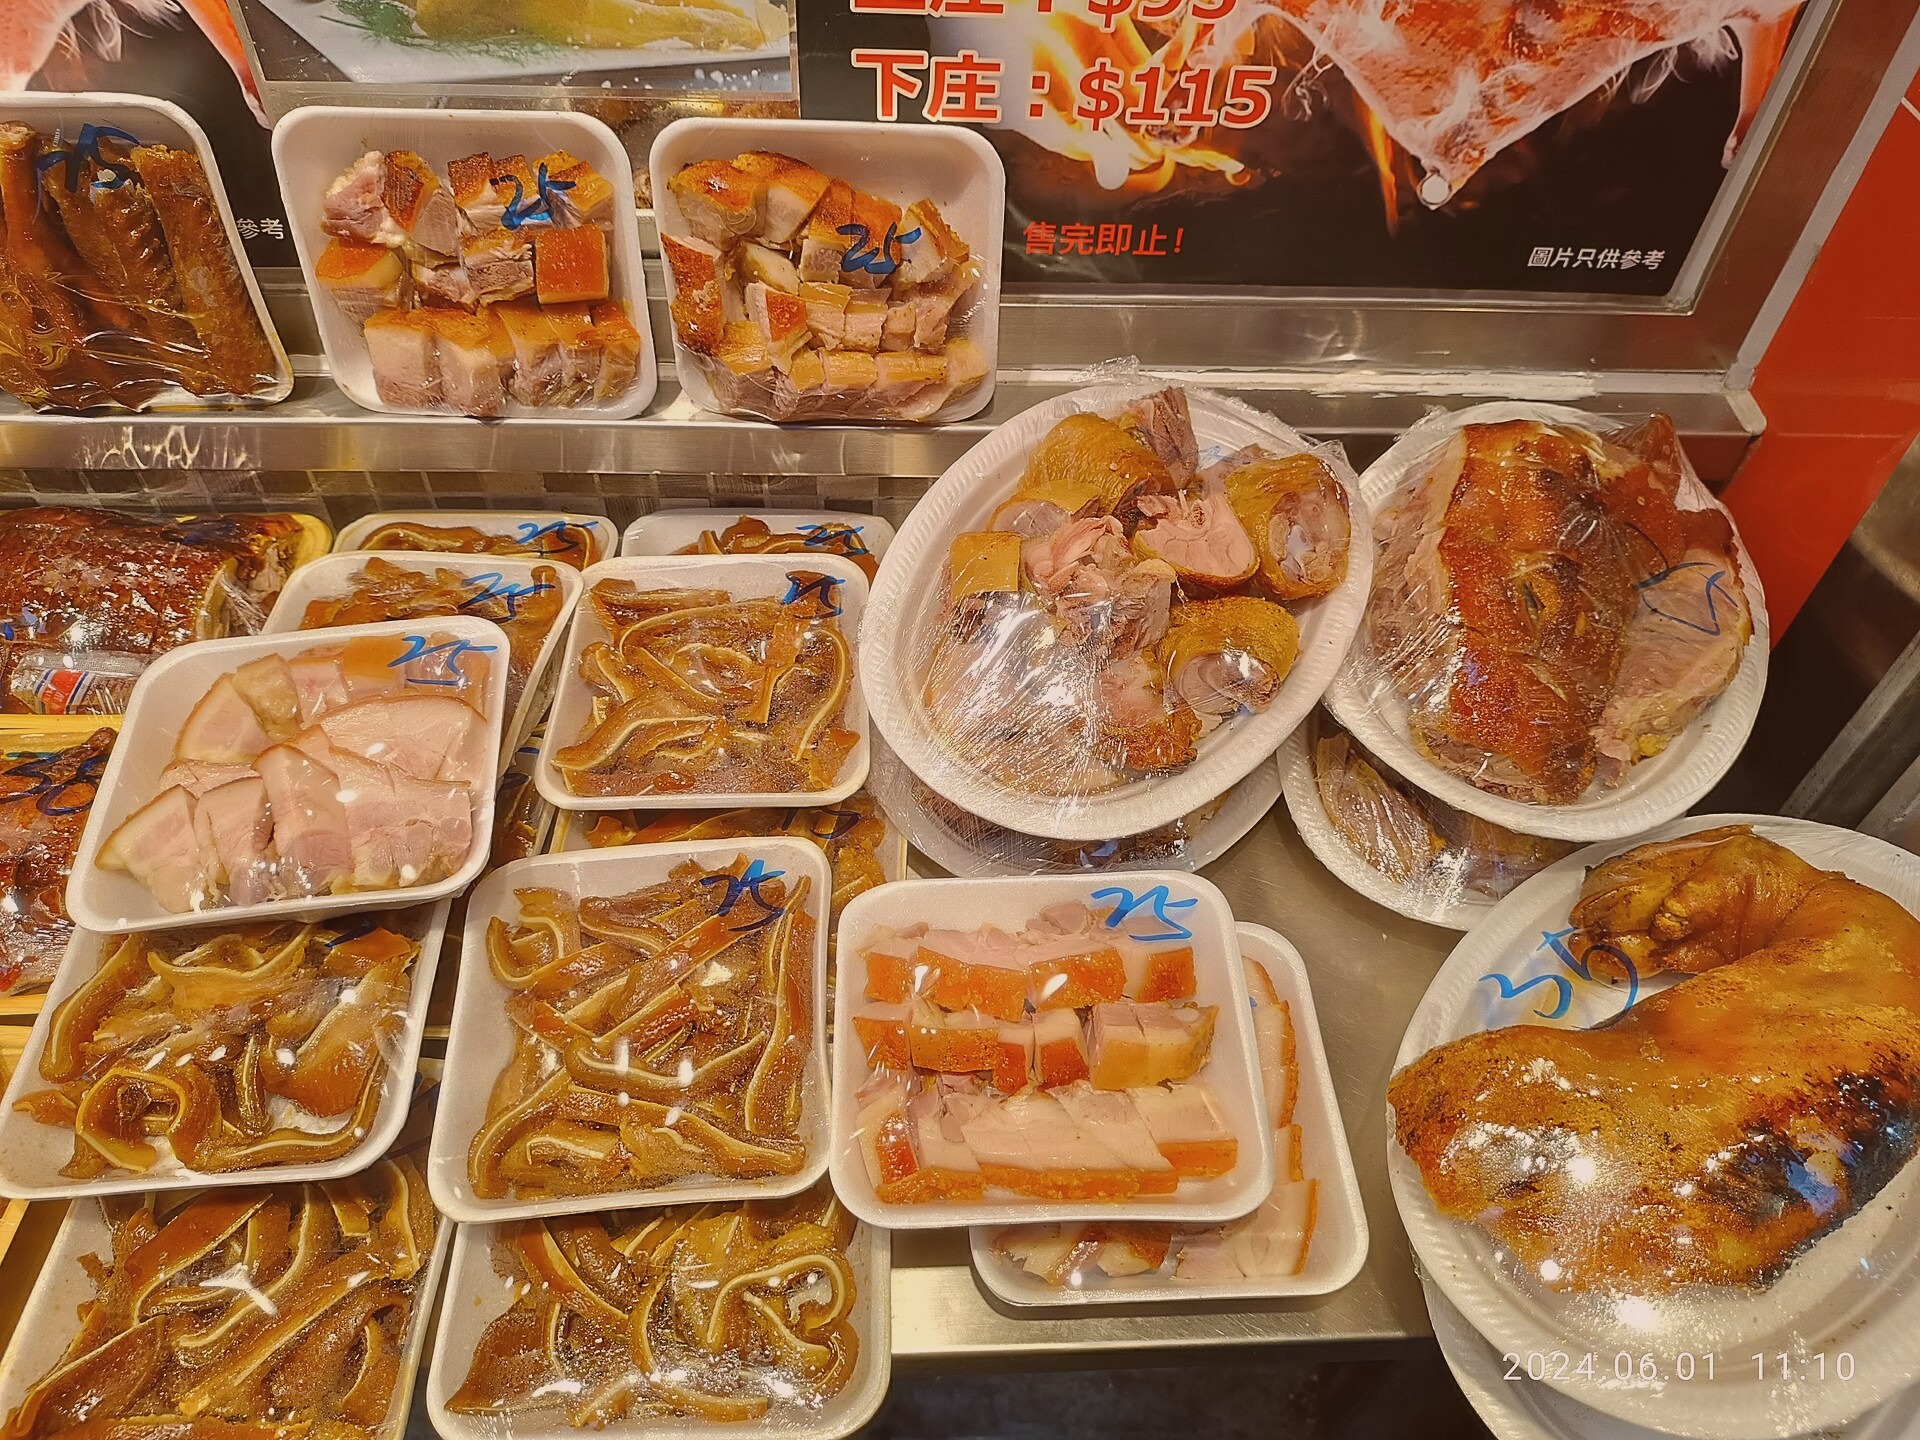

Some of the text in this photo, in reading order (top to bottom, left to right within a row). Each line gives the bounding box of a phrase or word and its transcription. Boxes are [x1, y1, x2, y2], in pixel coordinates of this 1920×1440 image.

[835, 221, 923, 275] 25
[1527, 246, 1666, 271] 圖片只供參考
[386, 635, 499, 687] 25
[1090, 885, 1199, 942] 25
[1478, 930, 1639, 1031] 35
